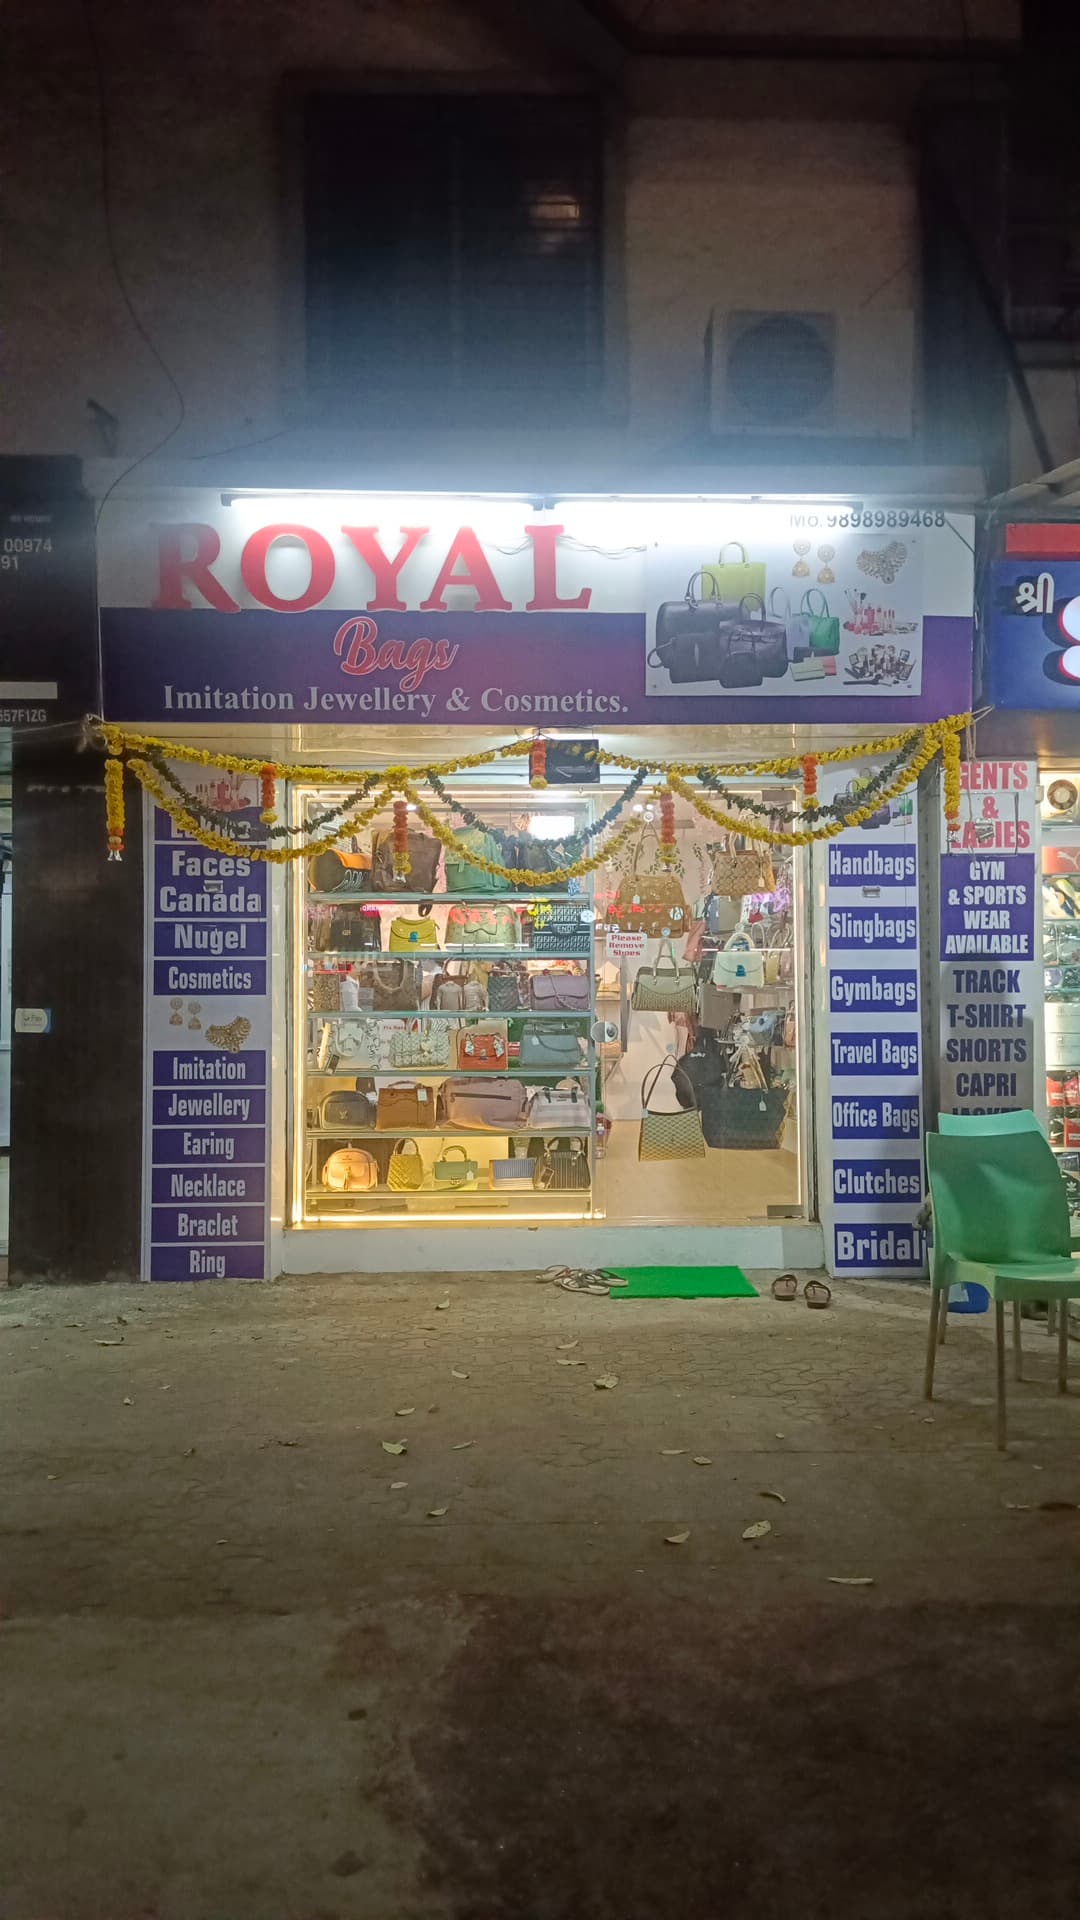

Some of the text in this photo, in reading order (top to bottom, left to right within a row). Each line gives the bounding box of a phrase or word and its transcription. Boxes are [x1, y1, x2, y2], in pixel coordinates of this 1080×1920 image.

[4, 538, 52, 553] 00974
[150, 523, 592, 613] ROYAL
[1015, 572, 1054, 613] श्री
[334, 616, 459, 692] Bags
[164, 685, 629, 717] Imitation Jewellery & Cosmetics.
[982, 796, 999, 819] &
[172, 850, 250, 877] Faces
[829, 850, 915, 881] Handbags
[969, 861, 1005, 881] GYM
[160, 886, 262, 913] Canada
[947, 885, 1027, 905] & SPORTS
[829, 913, 916, 943] Slingbags
[963, 910, 1010, 930] WEAR
[174, 923, 247, 955] Nugel
[611, 934, 642, 942] Please
[945, 934, 1028, 954] AVAILABLE
[168, 965, 252, 990] Cosmetics
[831, 975, 916, 1006] Gymbags
[953, 969, 1020, 994] TRACK
[947, 1004, 1027, 1028] T-SHIRT
[832, 1038, 917, 1069] Travel Bags
[946, 1038, 1027, 1063] SHORTS
[172, 1056, 246, 1080] Imitation
[955, 1072, 1017, 1097] CAPRI
[168, 1092, 250, 1121] Jewellery
[832, 1101, 919, 1133] Office Bags
[183, 1132, 235, 1160] Earing
[171, 1173, 246, 1198] Necklace
[834, 1168, 920, 1194] Clutches
[177, 1212, 238, 1237] Braclet
[189, 1249, 226, 1278] Ring
